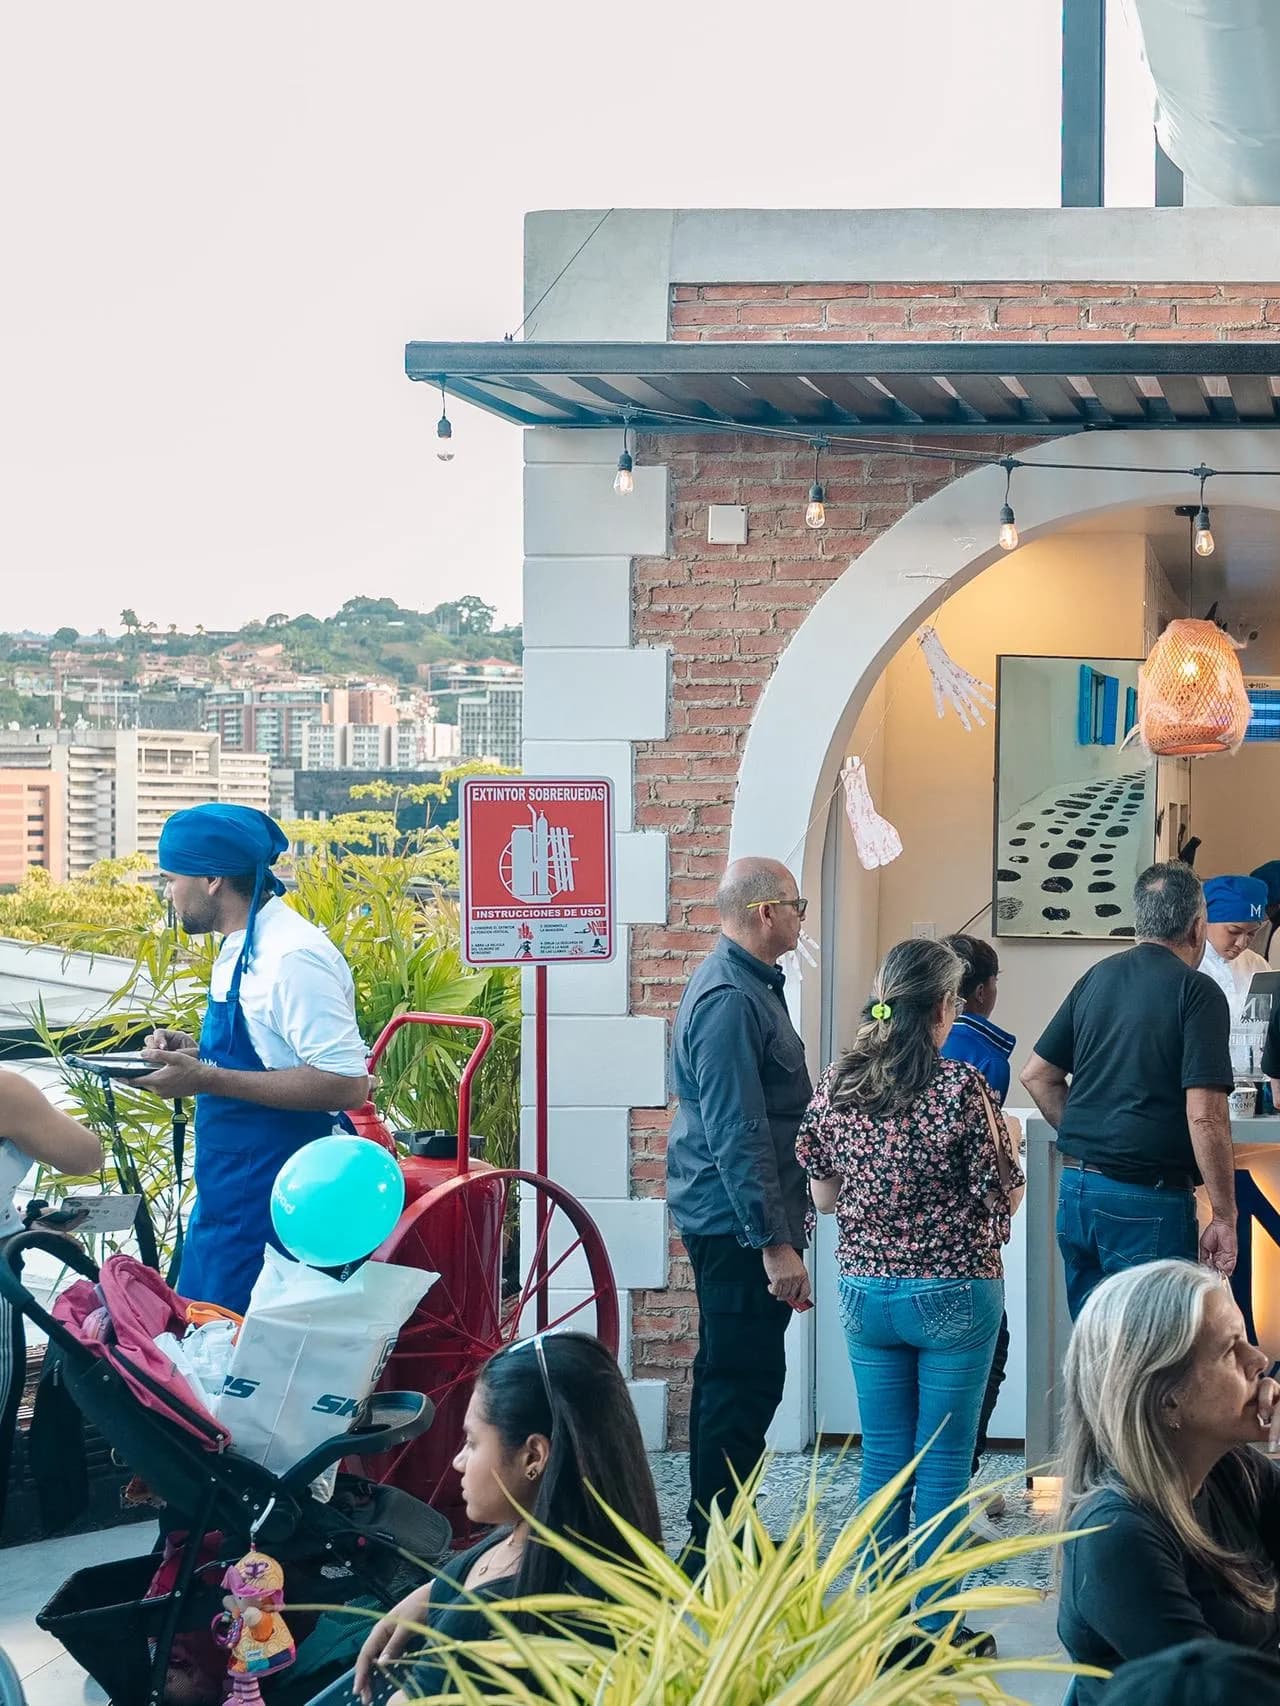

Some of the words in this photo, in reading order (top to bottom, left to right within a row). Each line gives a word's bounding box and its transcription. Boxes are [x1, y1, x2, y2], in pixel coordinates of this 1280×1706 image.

[472, 787, 526, 801] EXTINTOR
[528, 787, 605, 801] SOBRERUEDAS
[476, 909, 561, 919] INSTRUCCIONES
[563, 908, 578, 917] DE
[580, 908, 602, 916] USO
[1250, 903, 1262, 918] M
